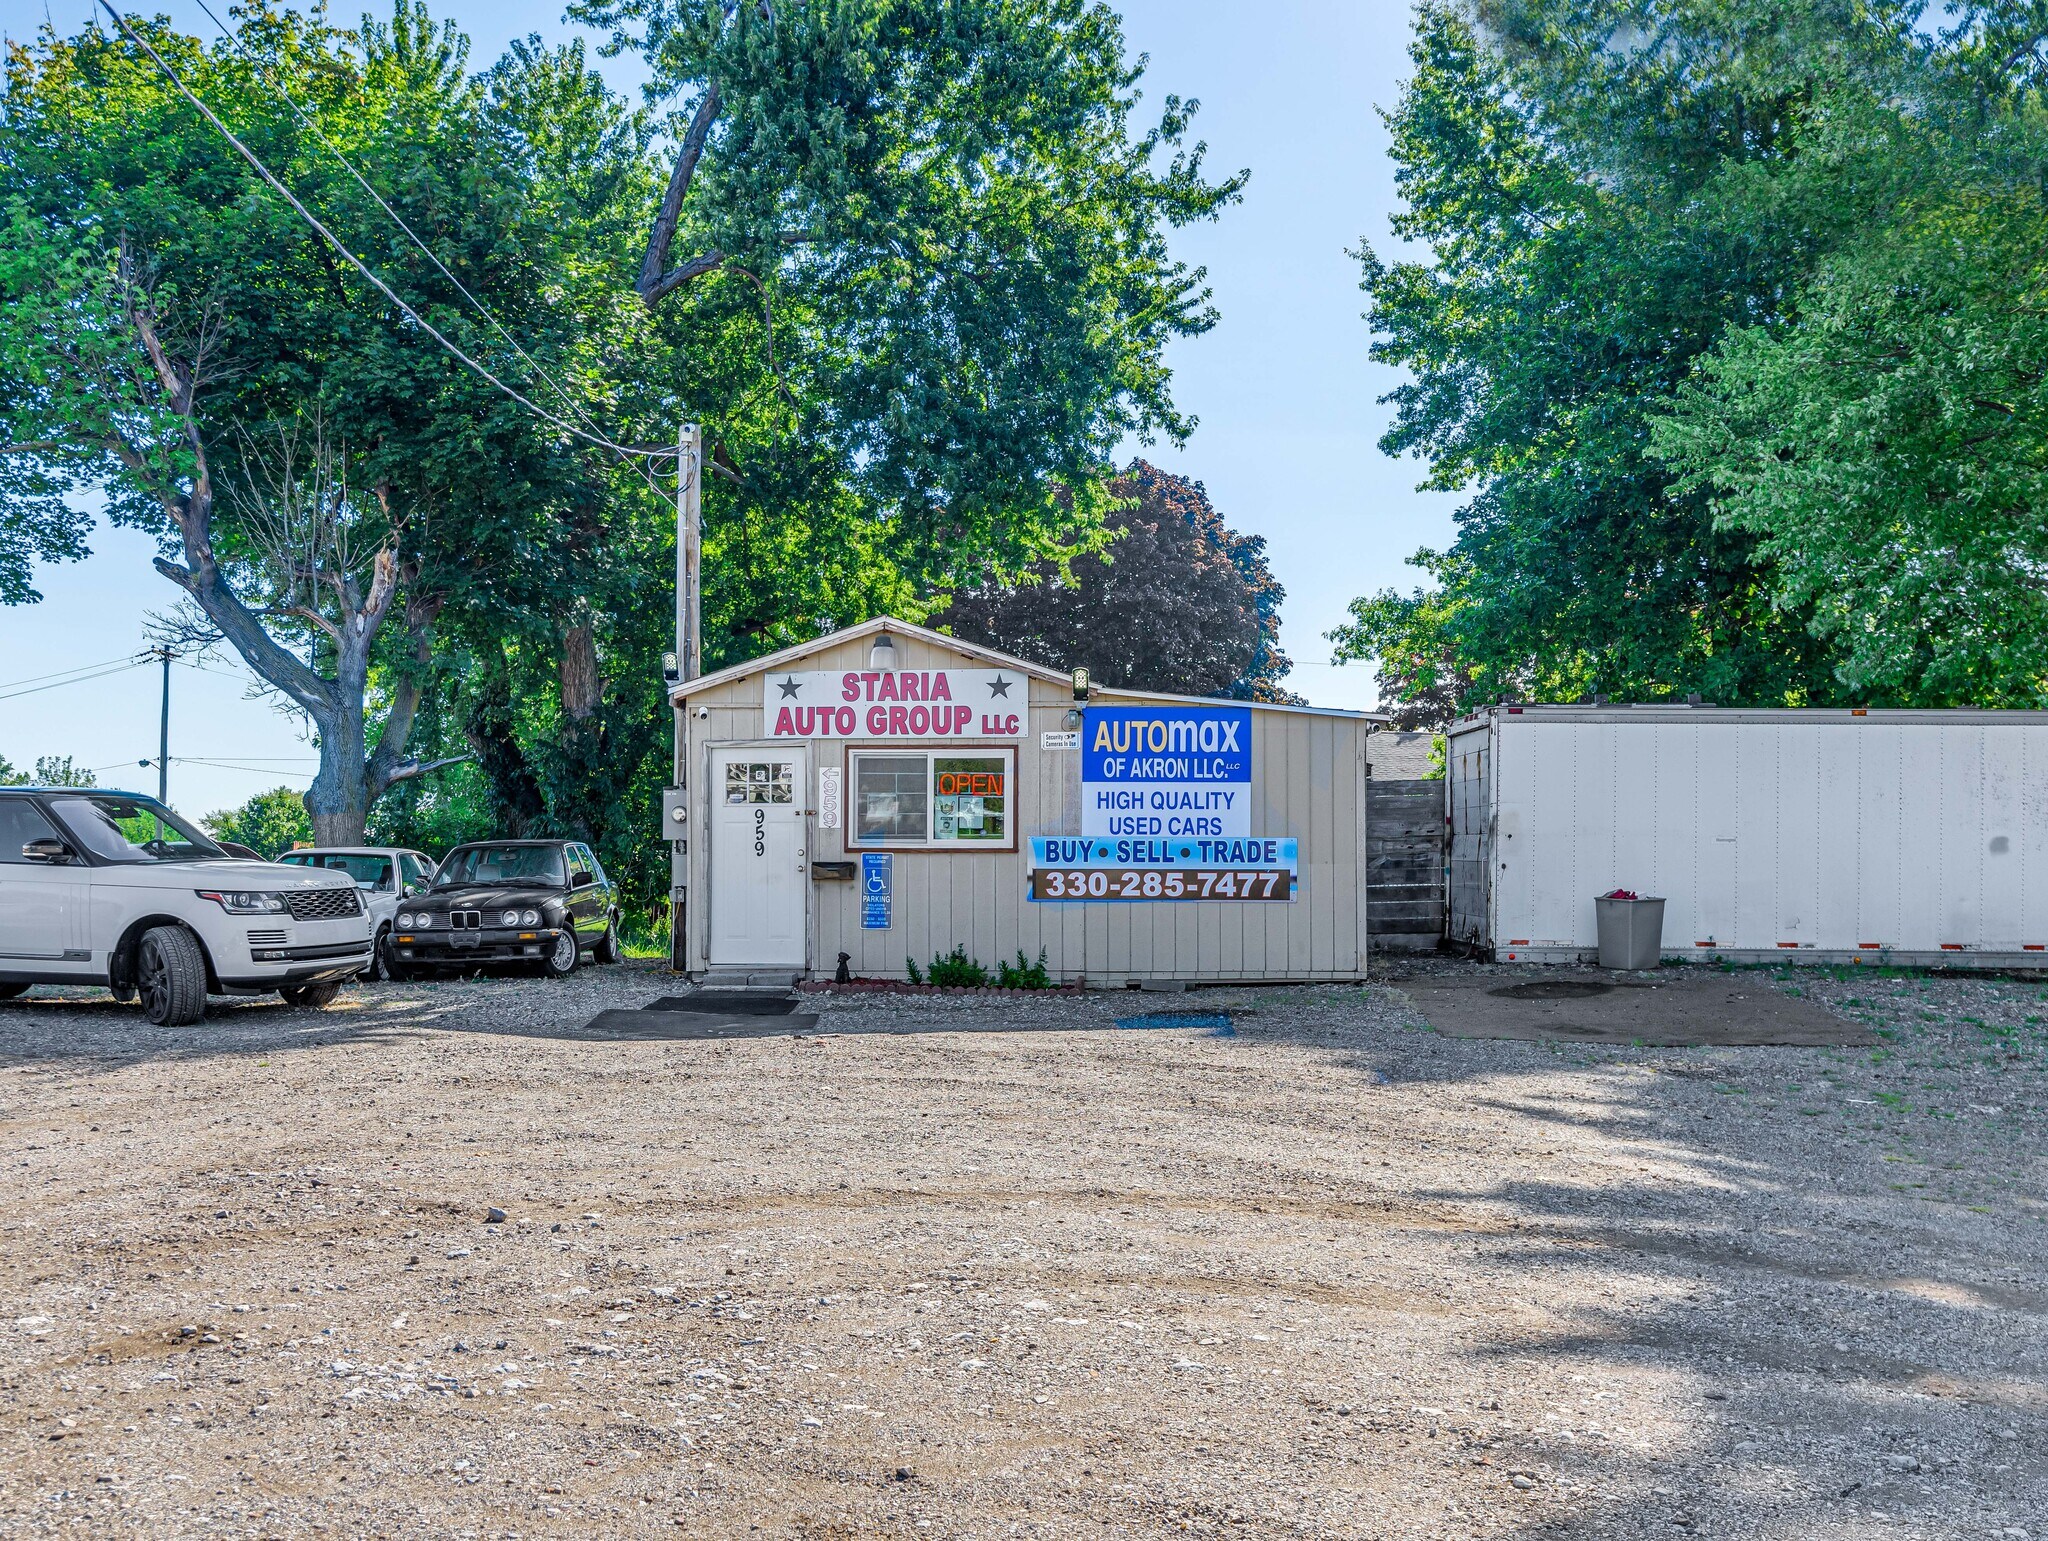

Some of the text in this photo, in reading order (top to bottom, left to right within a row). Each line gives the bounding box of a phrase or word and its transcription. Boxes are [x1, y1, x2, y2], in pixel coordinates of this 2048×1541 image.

[842, 672, 953, 702] STARIA
[774, 705, 1020, 735] AUTO GROUP LLC
[1103, 757, 1126, 778] OF
[1130, 757, 1189, 778] AKRON
[1193, 757, 1228, 778] LLC.
[939, 773, 1003, 796] OPEN
[823, 780, 838, 828] 959
[1097, 791, 1236, 810] HIGH QUALITY
[754, 808, 765, 857] 959
[1109, 817, 1223, 836] USED CARS
[1045, 840, 1277, 863] BUY SELL TRADE
[1045, 872, 1280, 898] 330-285-7477
[862, 895, 891, 903] PARKING
